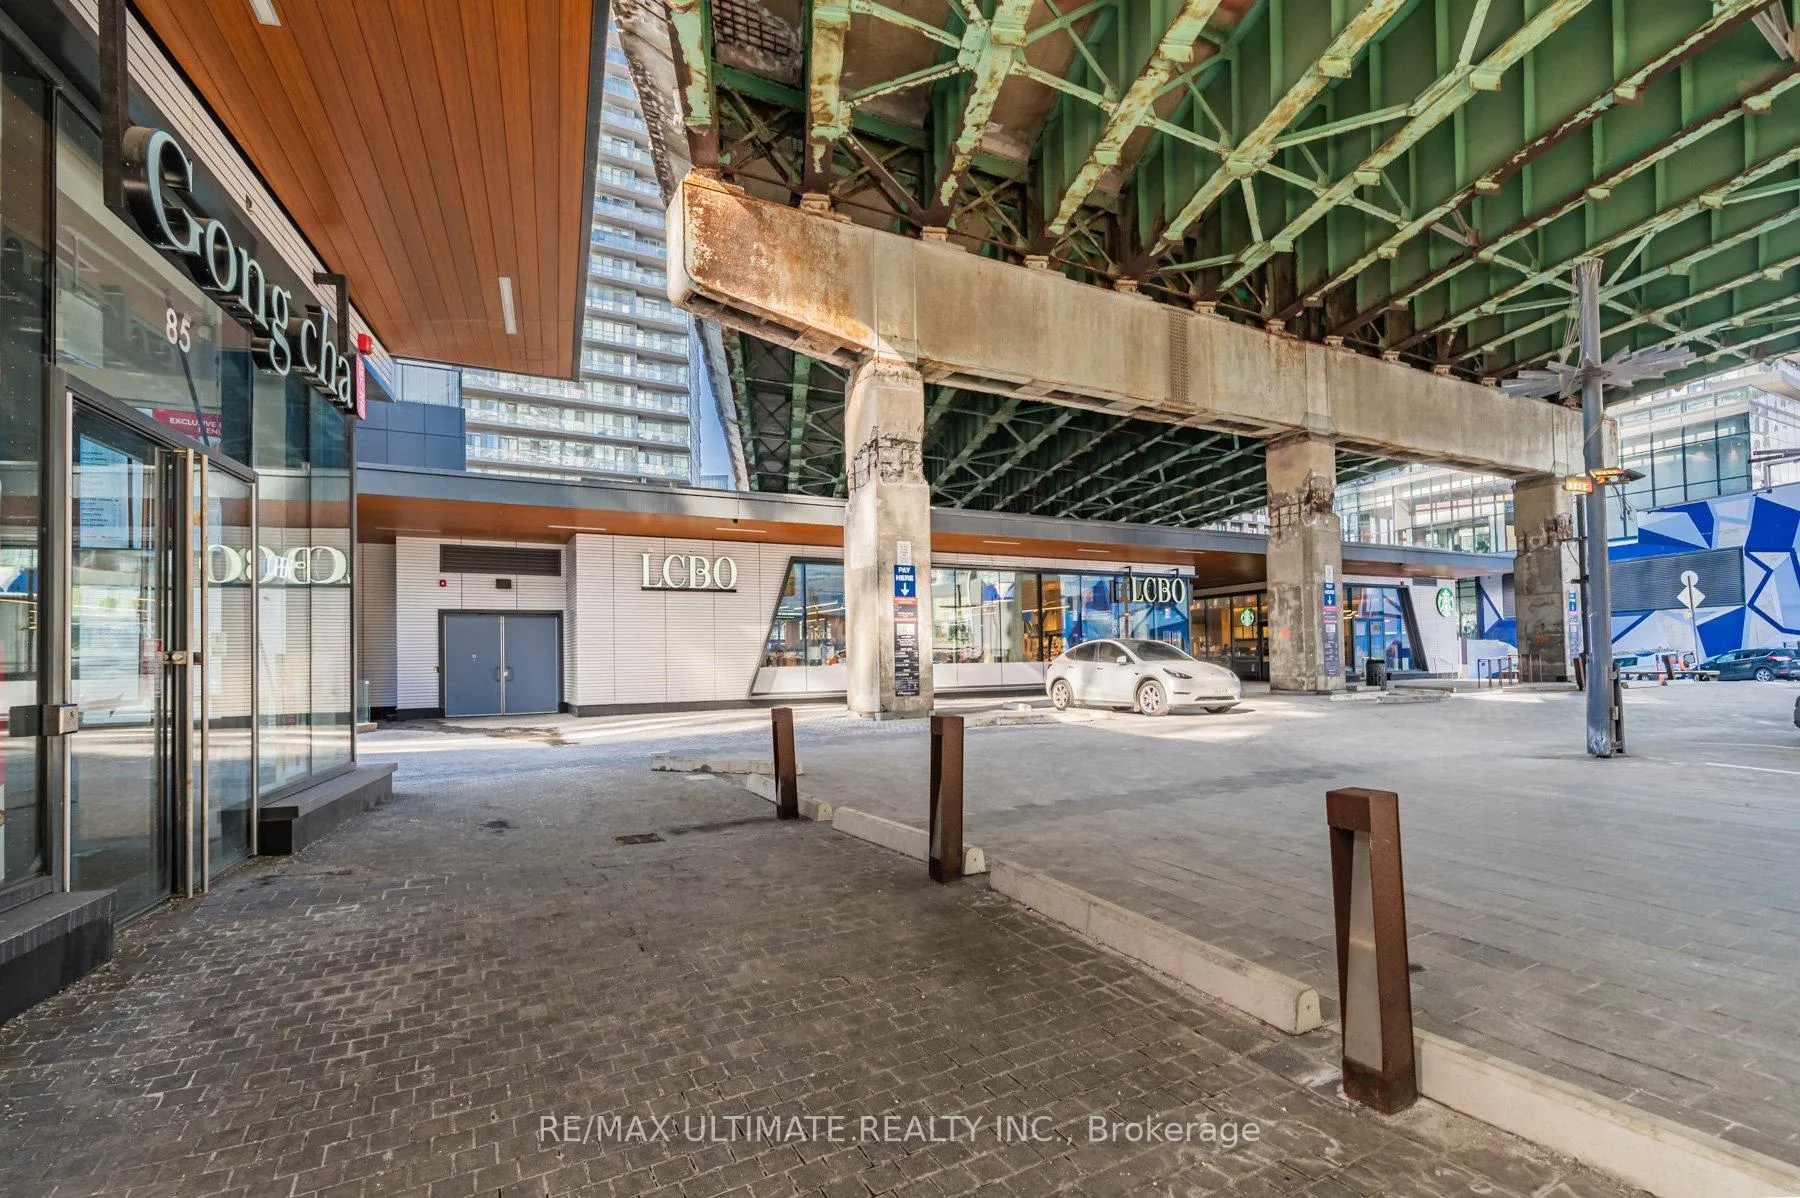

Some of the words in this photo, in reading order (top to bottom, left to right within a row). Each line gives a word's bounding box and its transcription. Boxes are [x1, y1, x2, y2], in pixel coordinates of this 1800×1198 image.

[145, 129, 292, 375] Gong
[301, 304, 353, 409] cha
[166, 308, 191, 352] 85
[169, 417, 217, 428] EXCLUIVE
[641, 553, 738, 589] LCBO
[1131, 576, 1186, 603] LCBO
